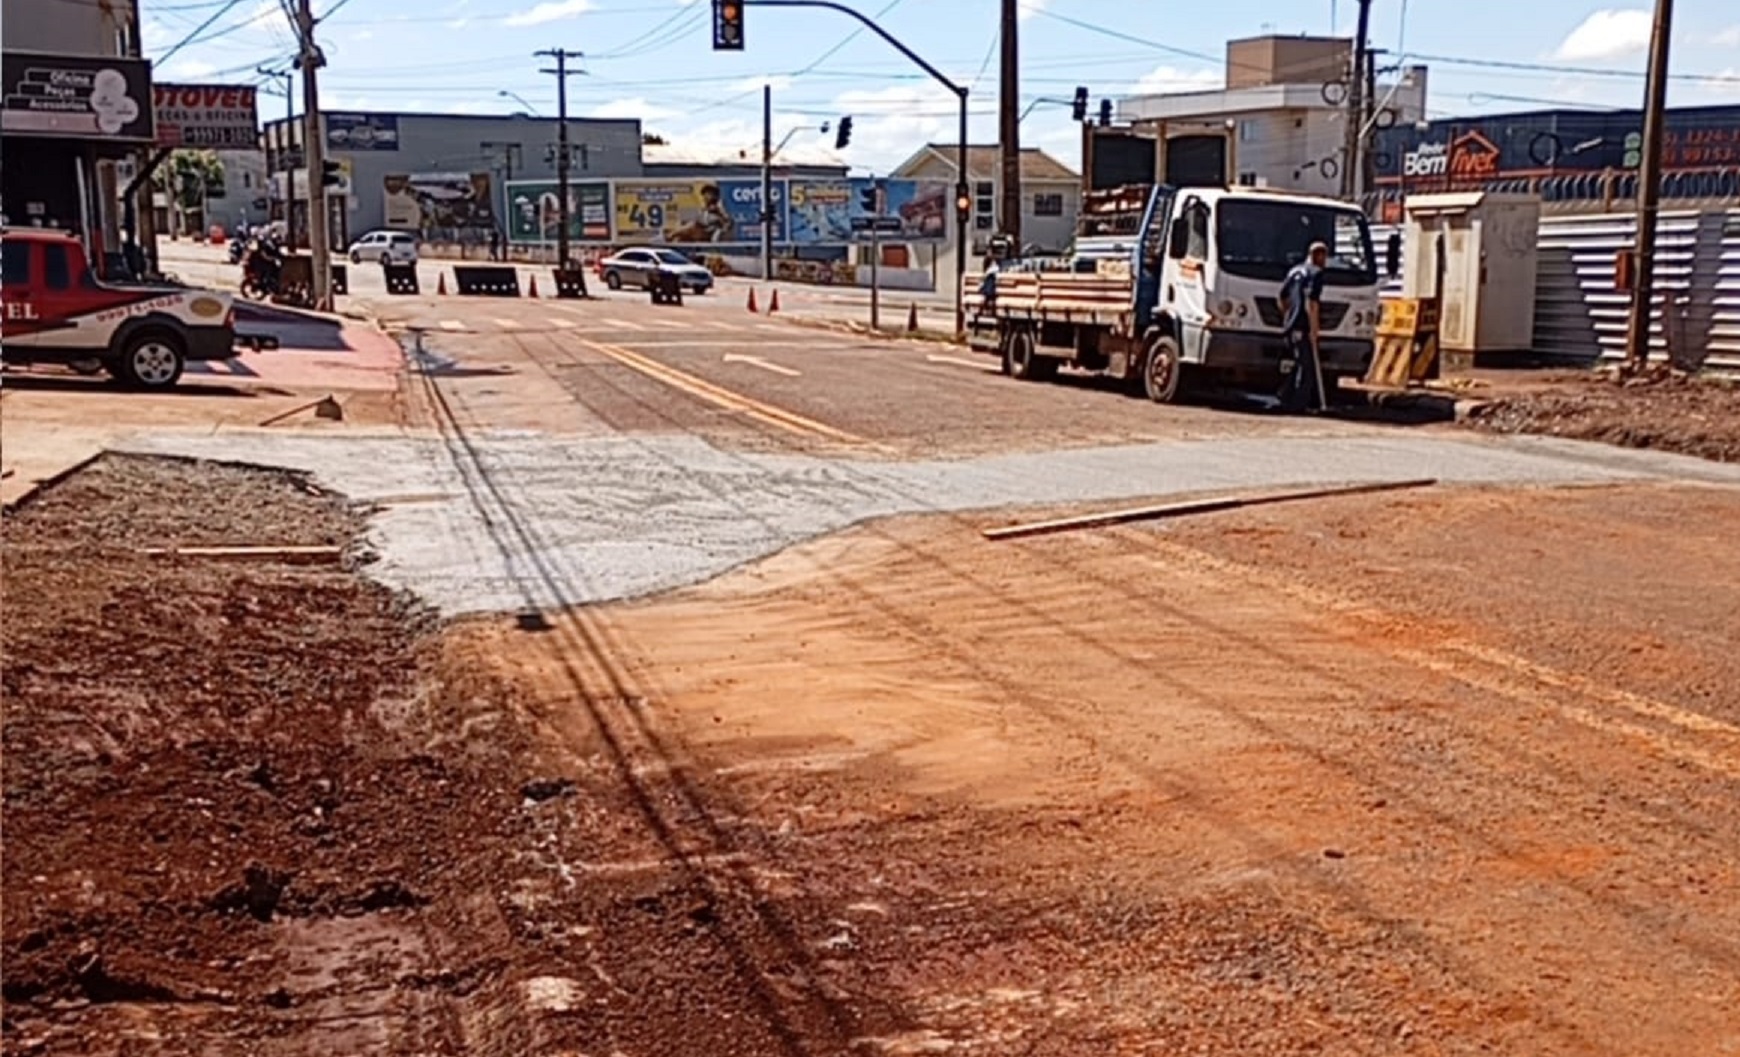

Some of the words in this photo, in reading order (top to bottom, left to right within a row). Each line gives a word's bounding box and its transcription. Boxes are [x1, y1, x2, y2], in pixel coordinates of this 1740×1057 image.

[50, 70, 90, 85] Oficina
[44, 83, 75, 98] Peças
[1404, 152, 1448, 175] Bem
[629, 203, 663, 229] 49
[2, 302, 40, 320] EL
